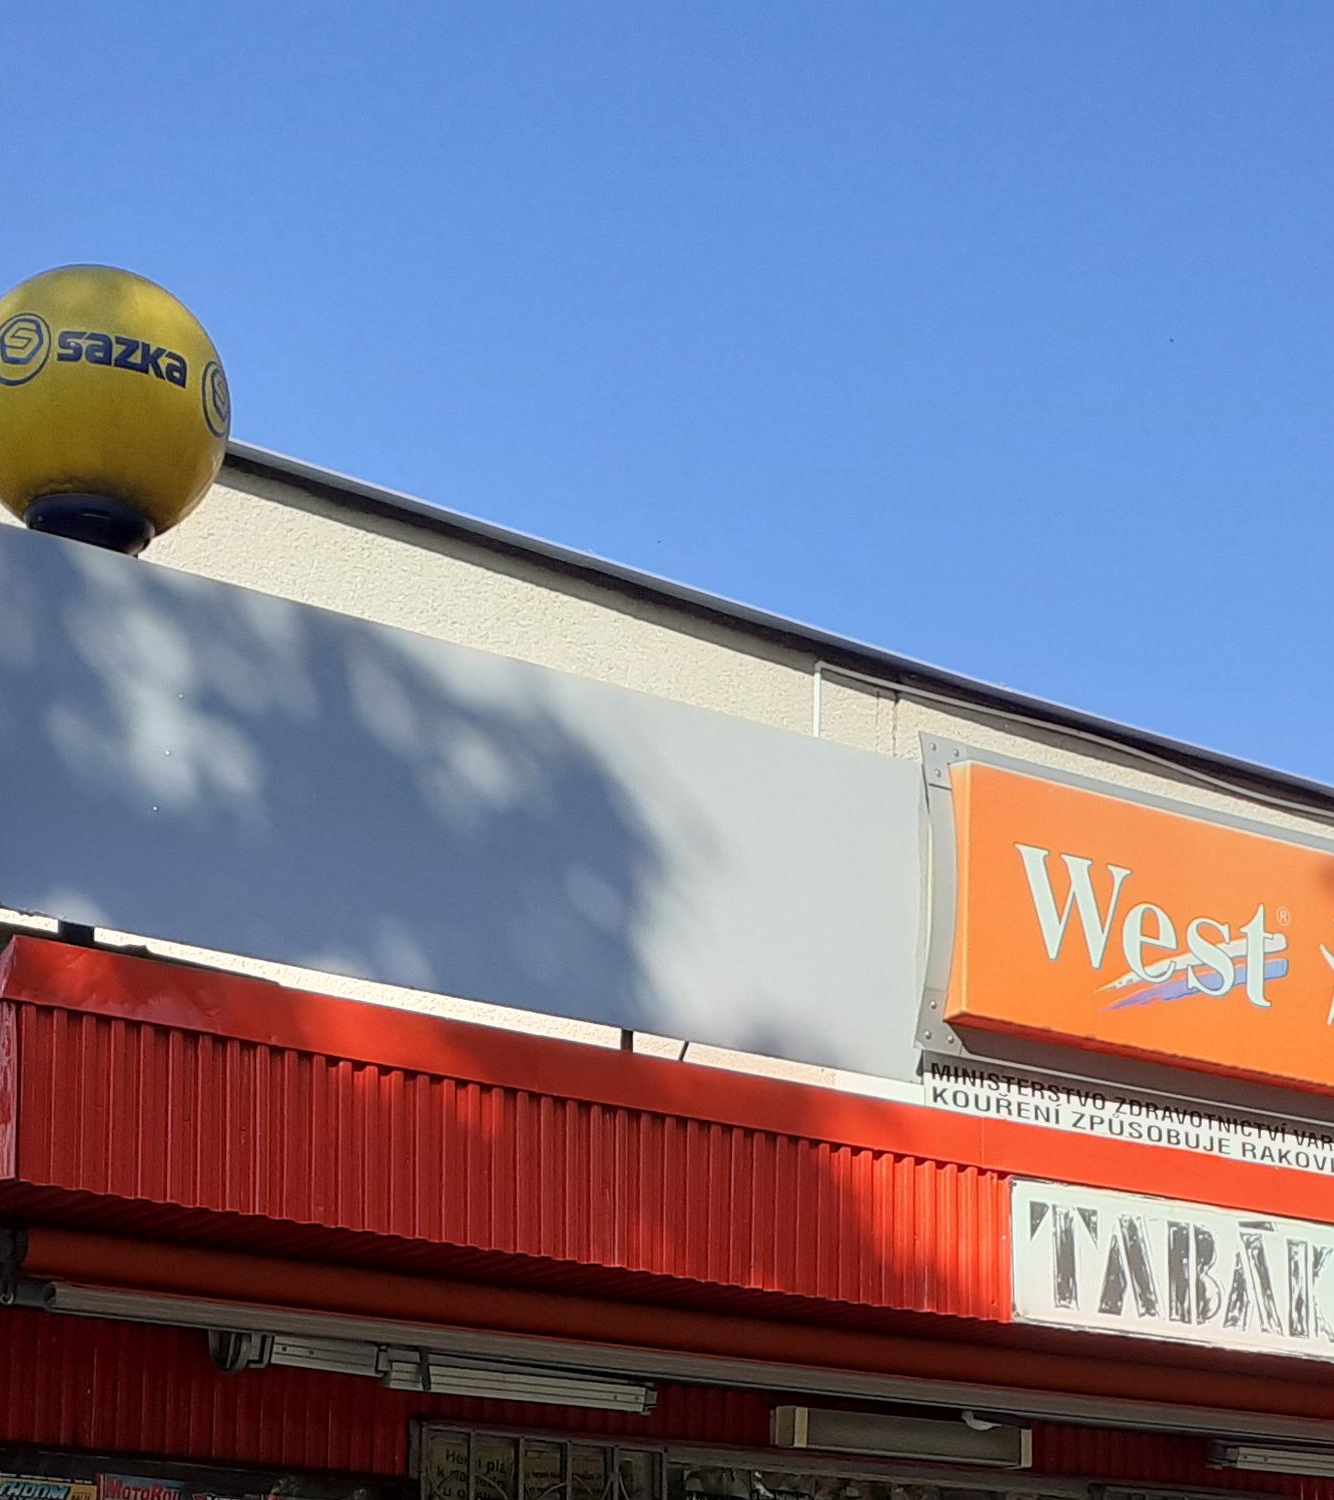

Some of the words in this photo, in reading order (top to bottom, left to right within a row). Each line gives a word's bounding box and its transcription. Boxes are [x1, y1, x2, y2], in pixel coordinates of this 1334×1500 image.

[1013, 842, 1273, 1007] West
[930, 1062, 1106, 1111] MINISTERSTVO
[1114, 1096, 1288, 1143] ZDRAVOTNICTVÍ
[932, 1086, 1061, 1125] KOUŘENÍ
[1071, 1111, 1232, 1155] ZPŮSOBUJE
